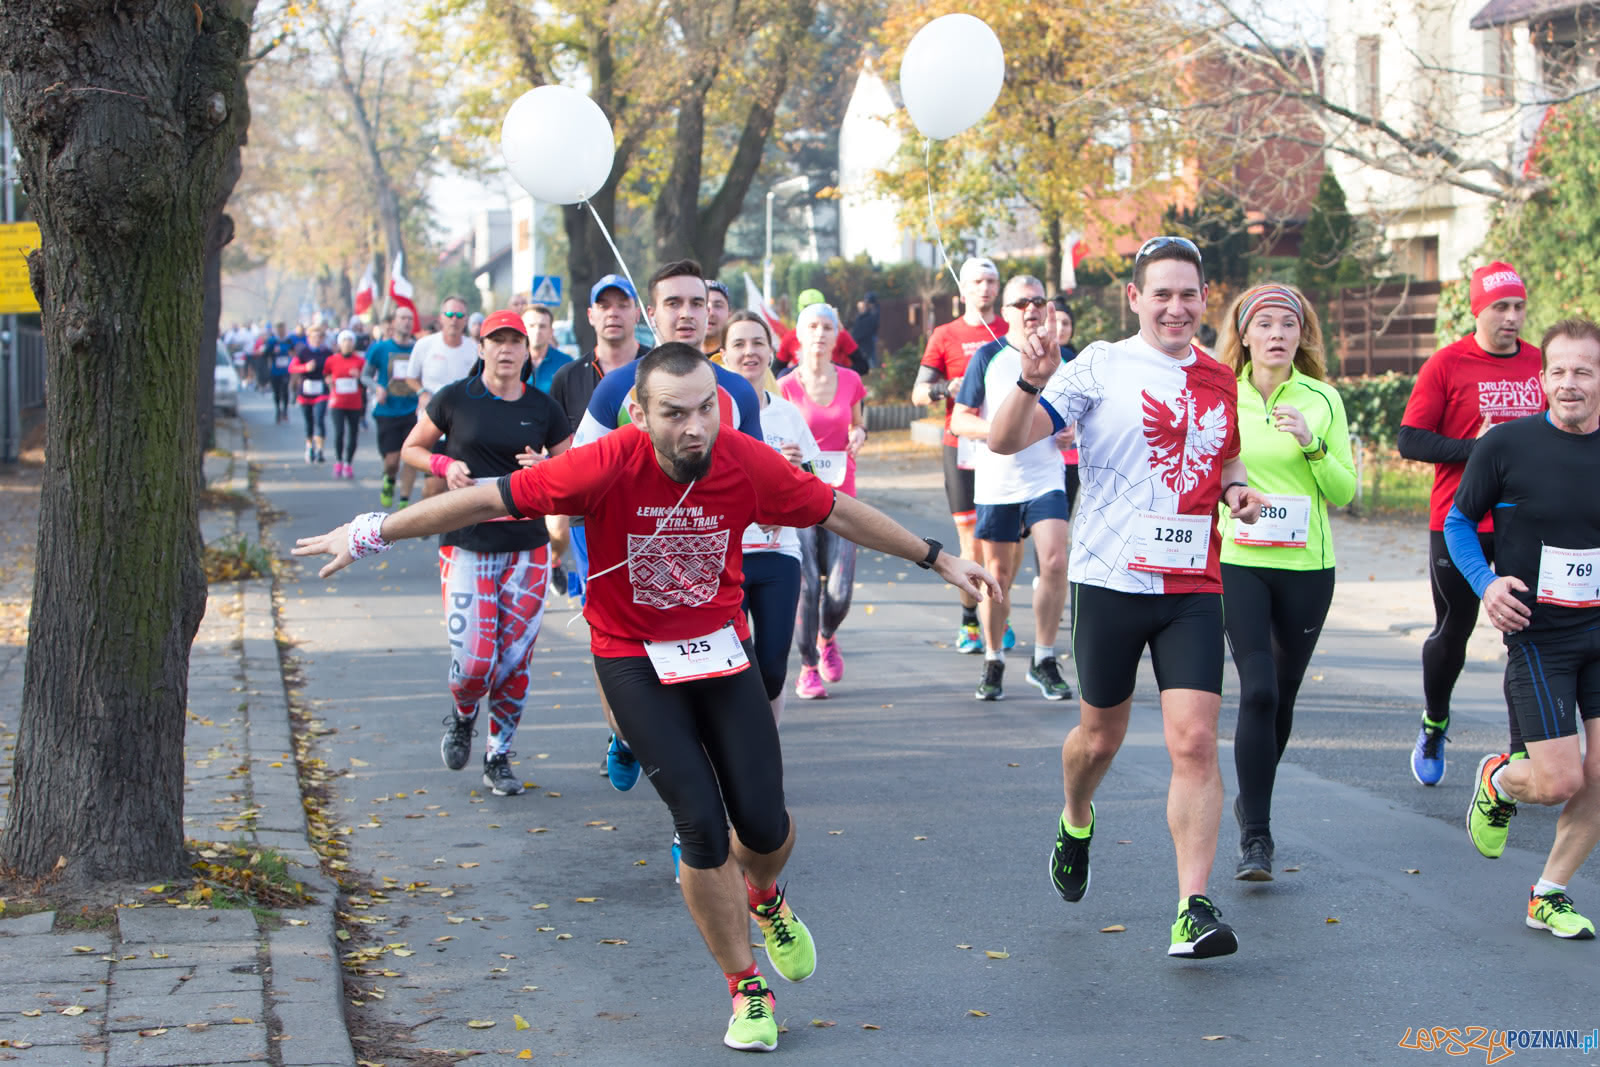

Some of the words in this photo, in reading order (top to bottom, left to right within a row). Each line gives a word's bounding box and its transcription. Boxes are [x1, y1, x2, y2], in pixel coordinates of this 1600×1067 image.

[1478, 379, 1532, 392] DRUŻYNA
[1479, 391, 1541, 408] SZPIKU
[1154, 527, 1193, 543] 1288
[1566, 563, 1593, 577] 769
[677, 640, 711, 656] 125
